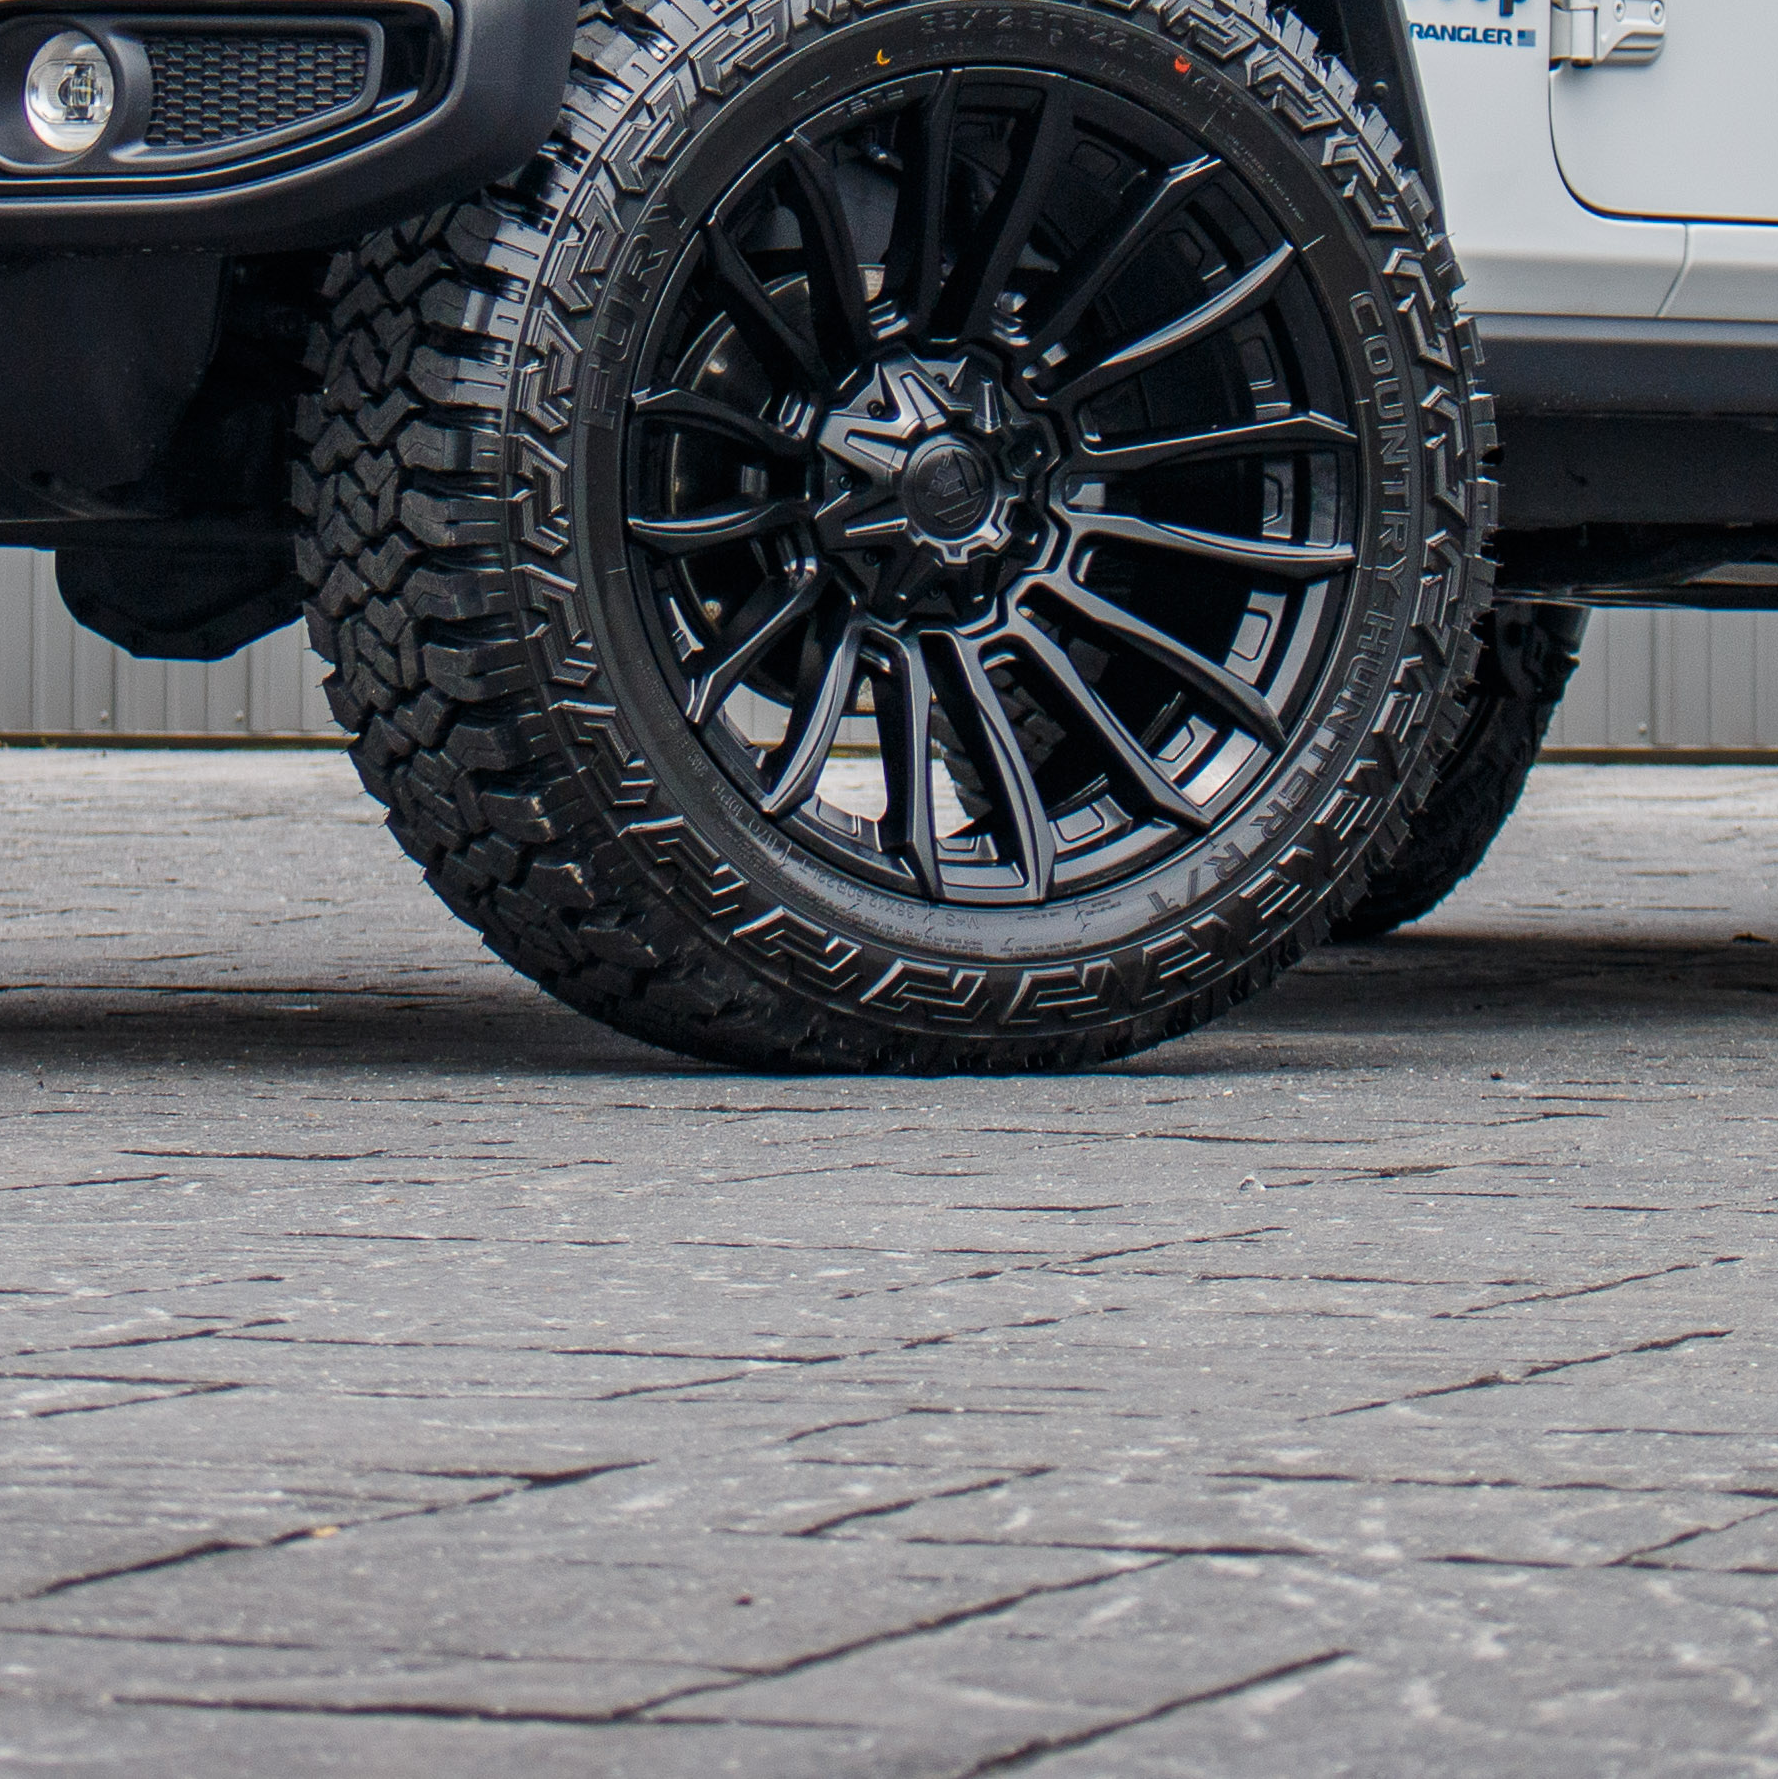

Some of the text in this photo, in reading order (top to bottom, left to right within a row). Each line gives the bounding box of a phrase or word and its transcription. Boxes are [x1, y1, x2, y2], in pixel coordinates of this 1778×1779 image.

[1409, 22, 1513, 47] RANGLER
[574, 171, 687, 429] FURY
[1141, 284, 1412, 926] COUNTRY HUNTER R/T
